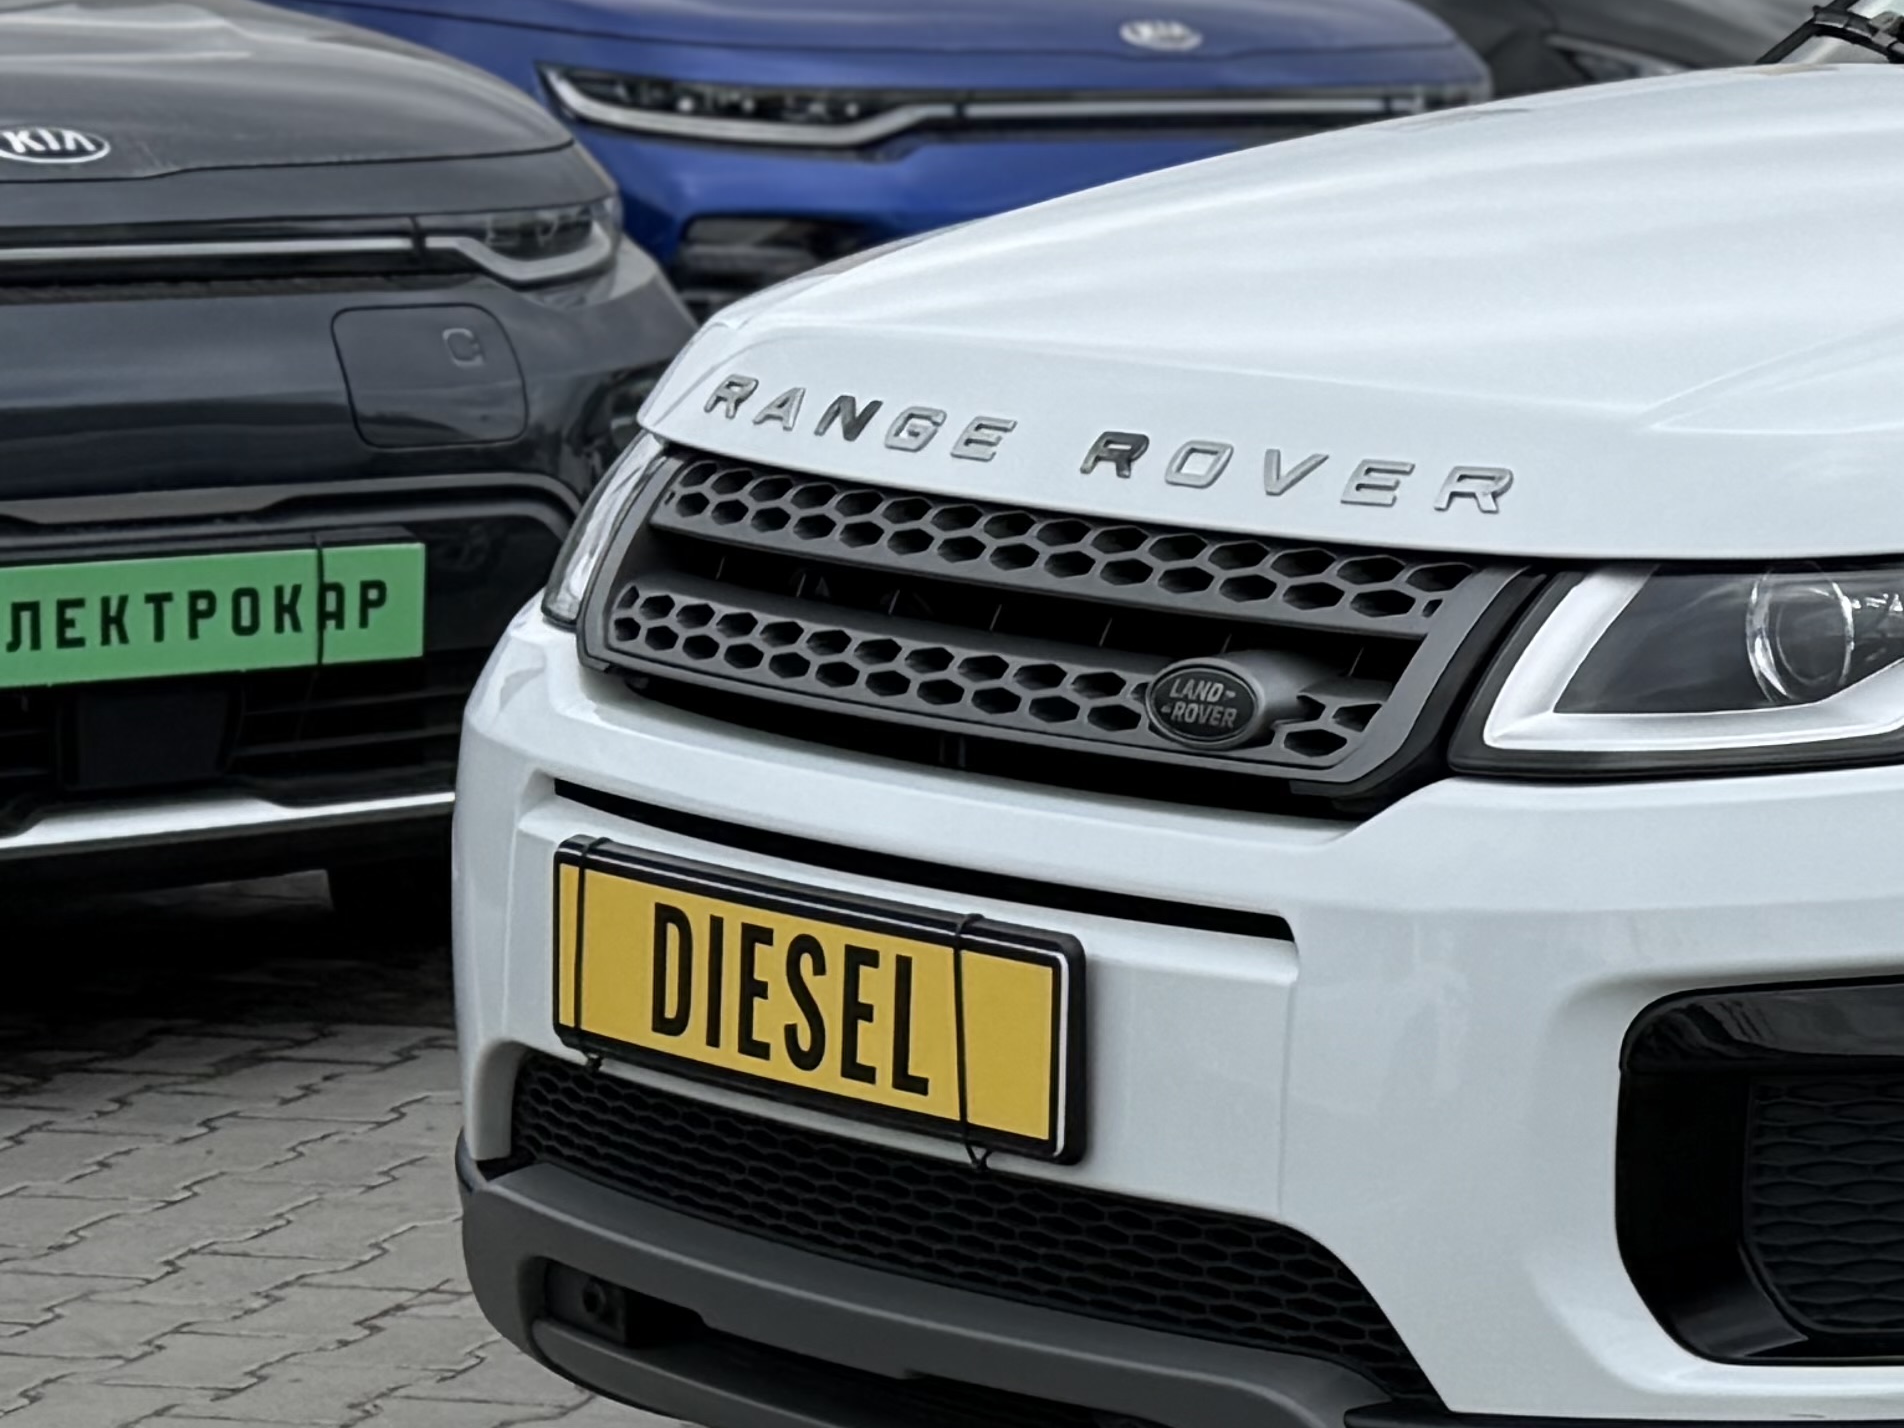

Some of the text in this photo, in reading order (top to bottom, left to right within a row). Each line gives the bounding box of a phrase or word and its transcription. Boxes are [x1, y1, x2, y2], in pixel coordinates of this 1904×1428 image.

[2, 127, 97, 153] KIA
[703, 373, 1515, 514] RANGE ROVER
[5, 578, 388, 653] ЛЕКТРОКАР
[1169, 677, 1224, 703] LAND
[1170, 700, 1238, 729] ROVER
[651, 901, 929, 1097] DIESEL
